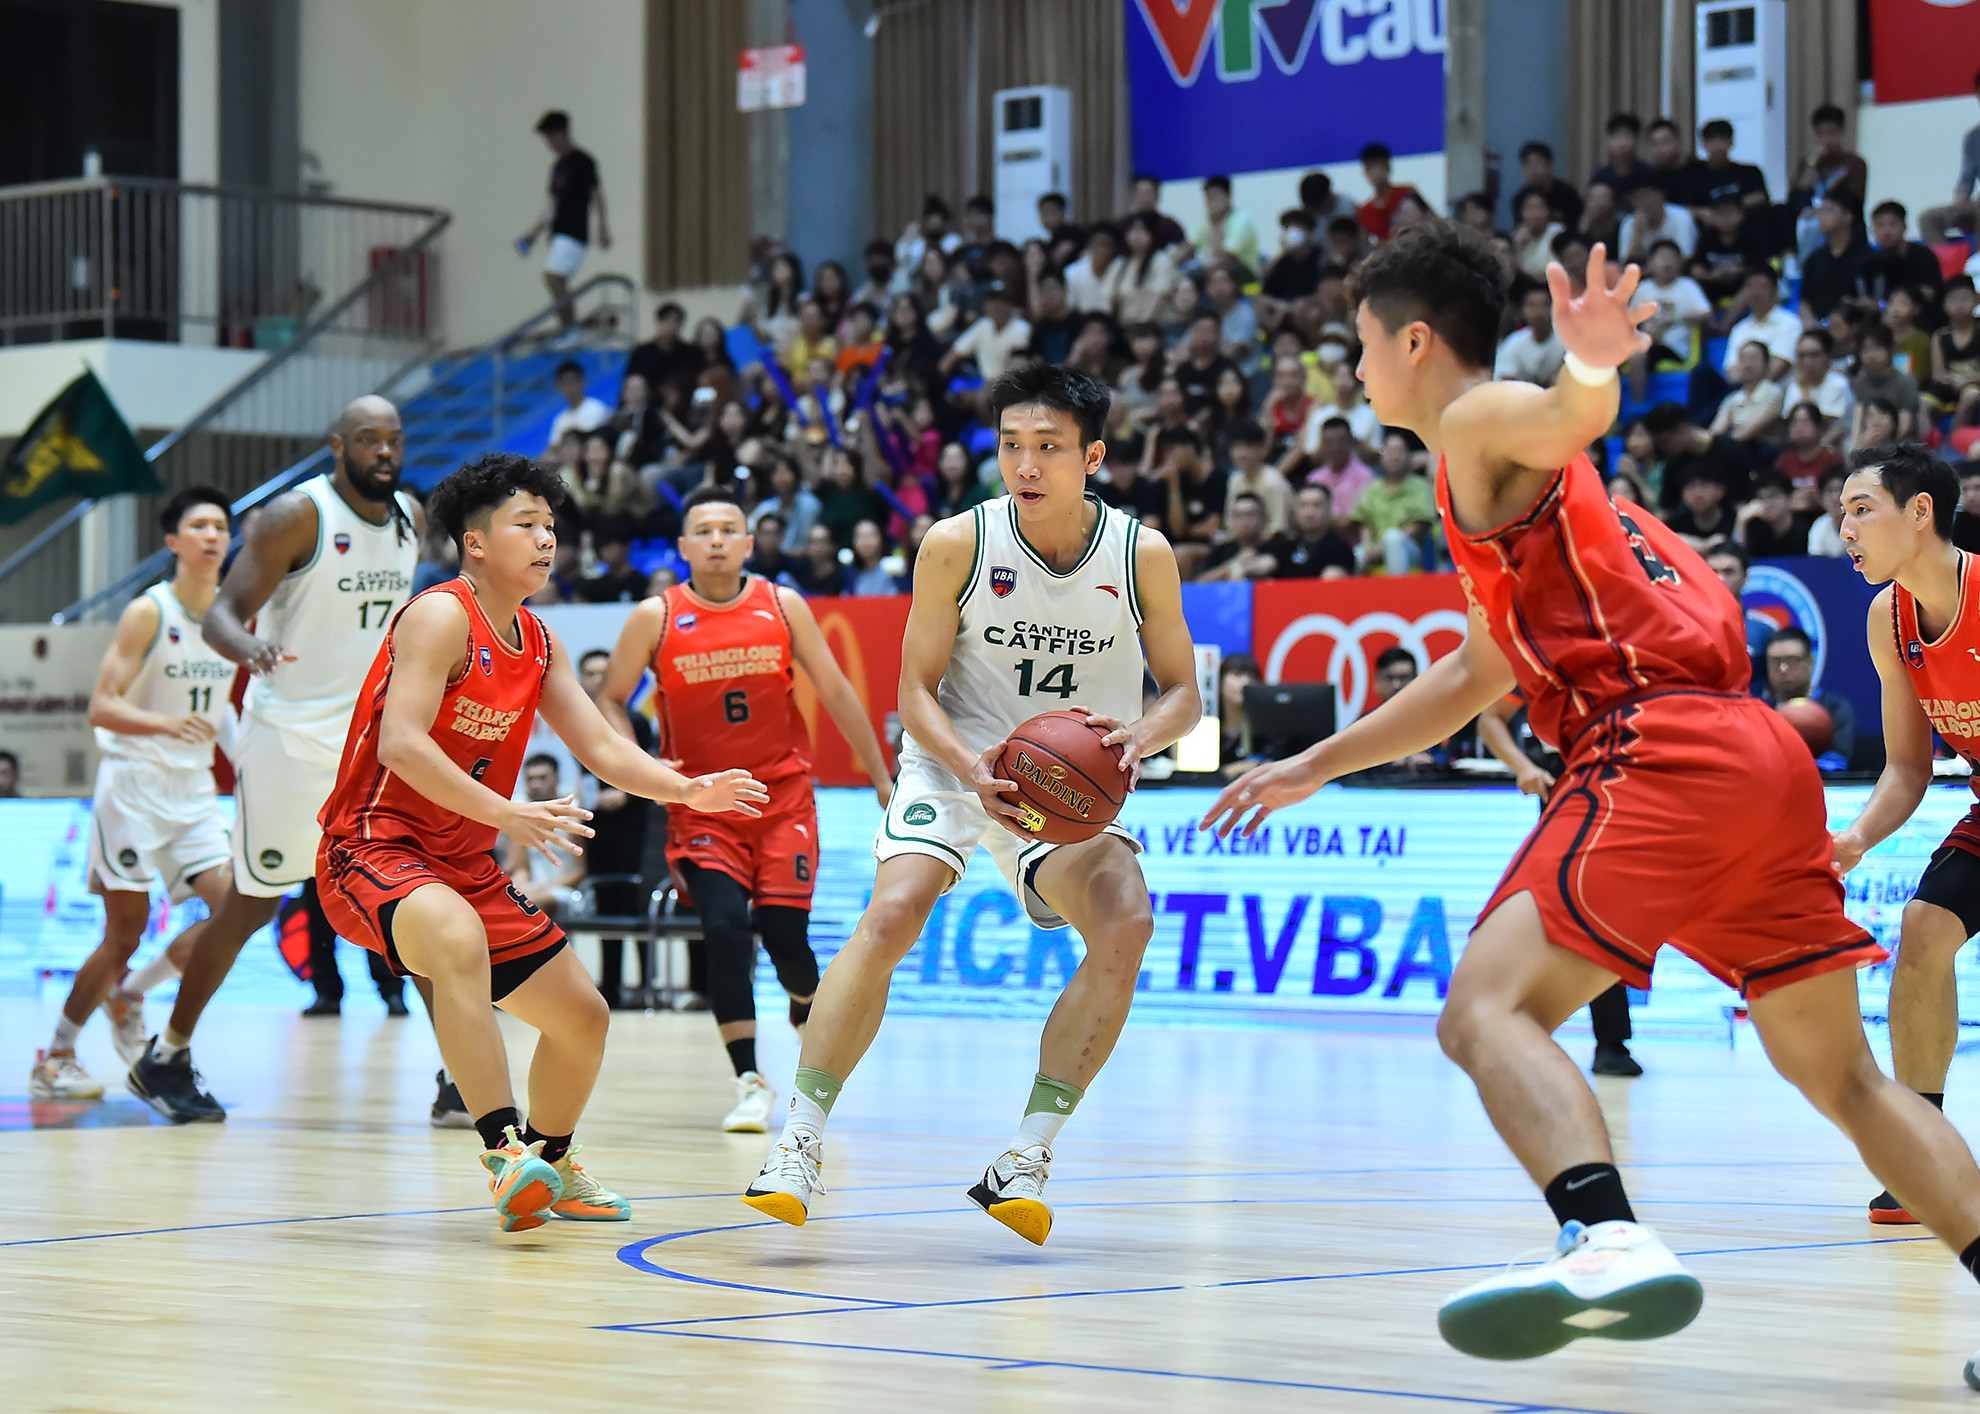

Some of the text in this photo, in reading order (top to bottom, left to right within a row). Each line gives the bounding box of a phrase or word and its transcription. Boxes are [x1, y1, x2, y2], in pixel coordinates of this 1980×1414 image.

[994, 570, 1014, 582] VBA
[358, 600, 393, 629] 17
[983, 625, 1116, 656] CATFISH
[1013, 620, 1091, 640] CANTHO
[1013, 657, 1080, 699] 14
[188, 686, 212, 713] 11
[723, 690, 750, 725] 6
[1010, 750, 1096, 818] SPALDING
[1284, 826, 1344, 856] VBA
[794, 853, 811, 884] 6
